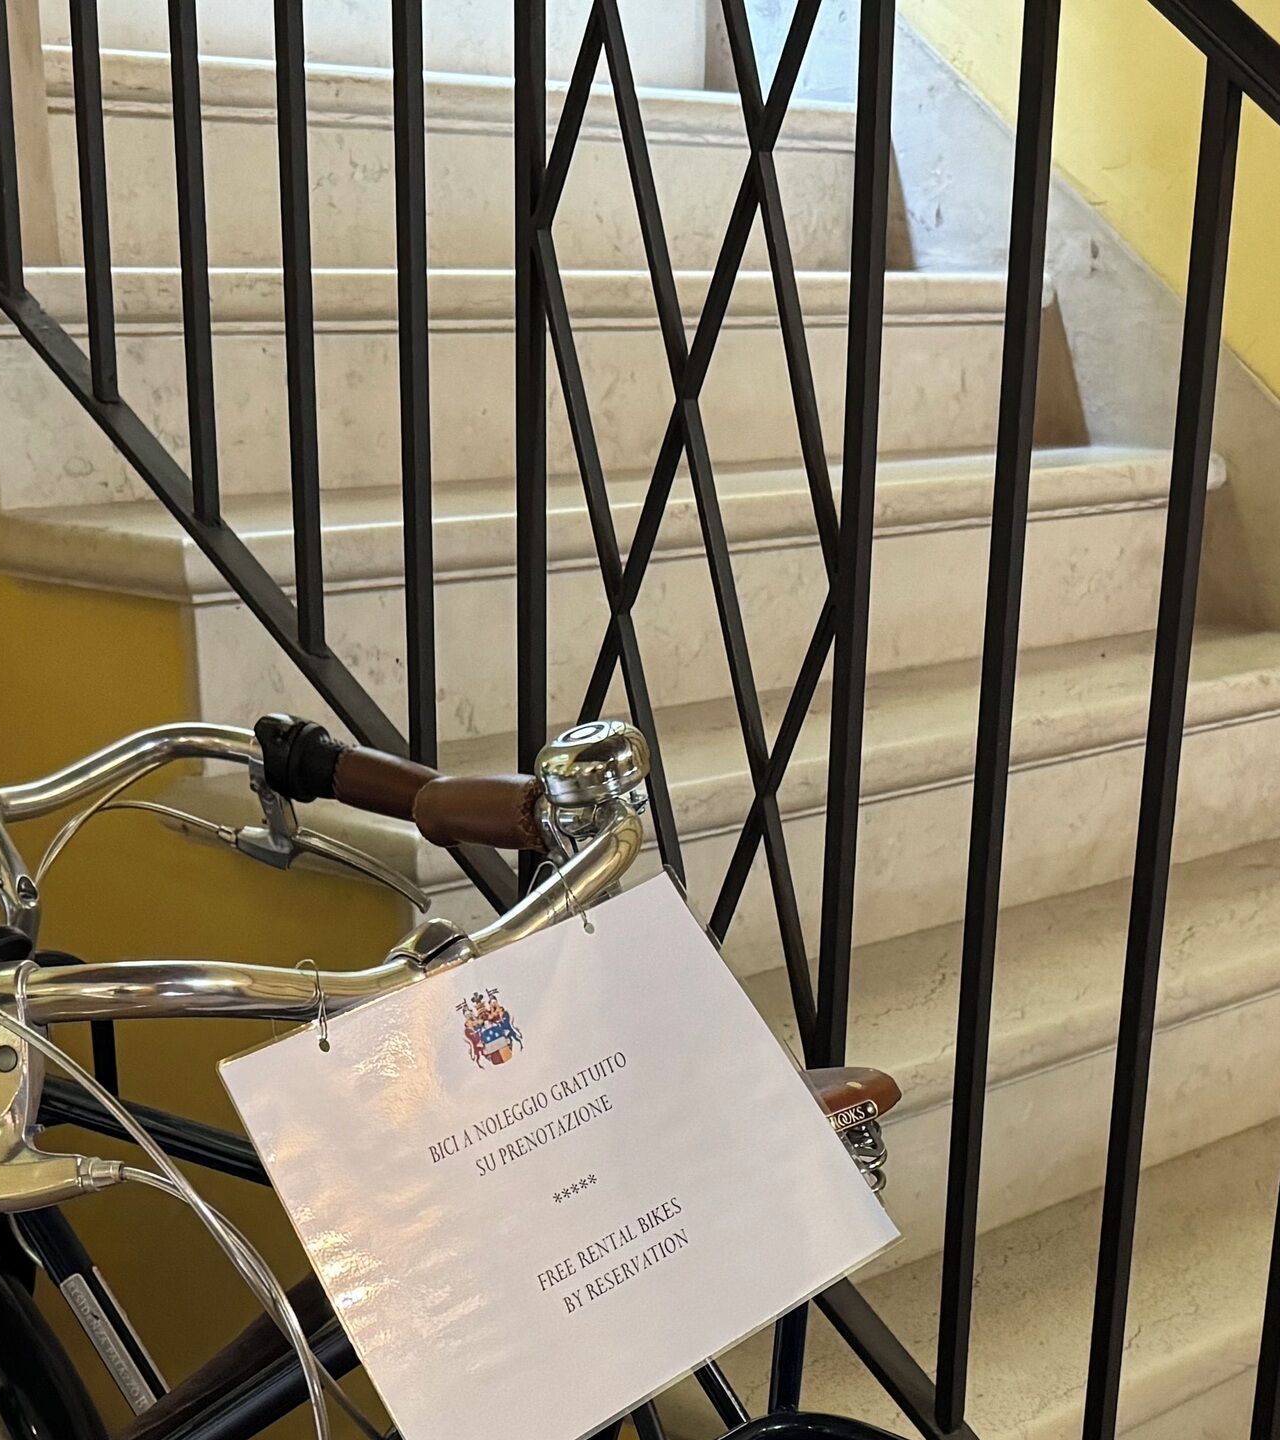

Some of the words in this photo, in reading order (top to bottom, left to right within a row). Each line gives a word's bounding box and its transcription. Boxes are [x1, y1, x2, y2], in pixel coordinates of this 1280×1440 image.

[428, 1134, 460, 1164] BICI
[464, 1128, 474, 1149] A
[473, 1092, 549, 1142] NOLEGGIO
[550, 1051, 627, 1102] GRATUITO
[475, 1153, 497, 1177] SU
[498, 1094, 613, 1166] PRENOTAZIONE
[536, 1257, 577, 1292] FREE
[577, 1224, 638, 1269] RENTAL
[637, 1197, 682, 1234] BIKES
[563, 1289, 584, 1314] BY
[585, 1228, 690, 1301] RESERVATION
